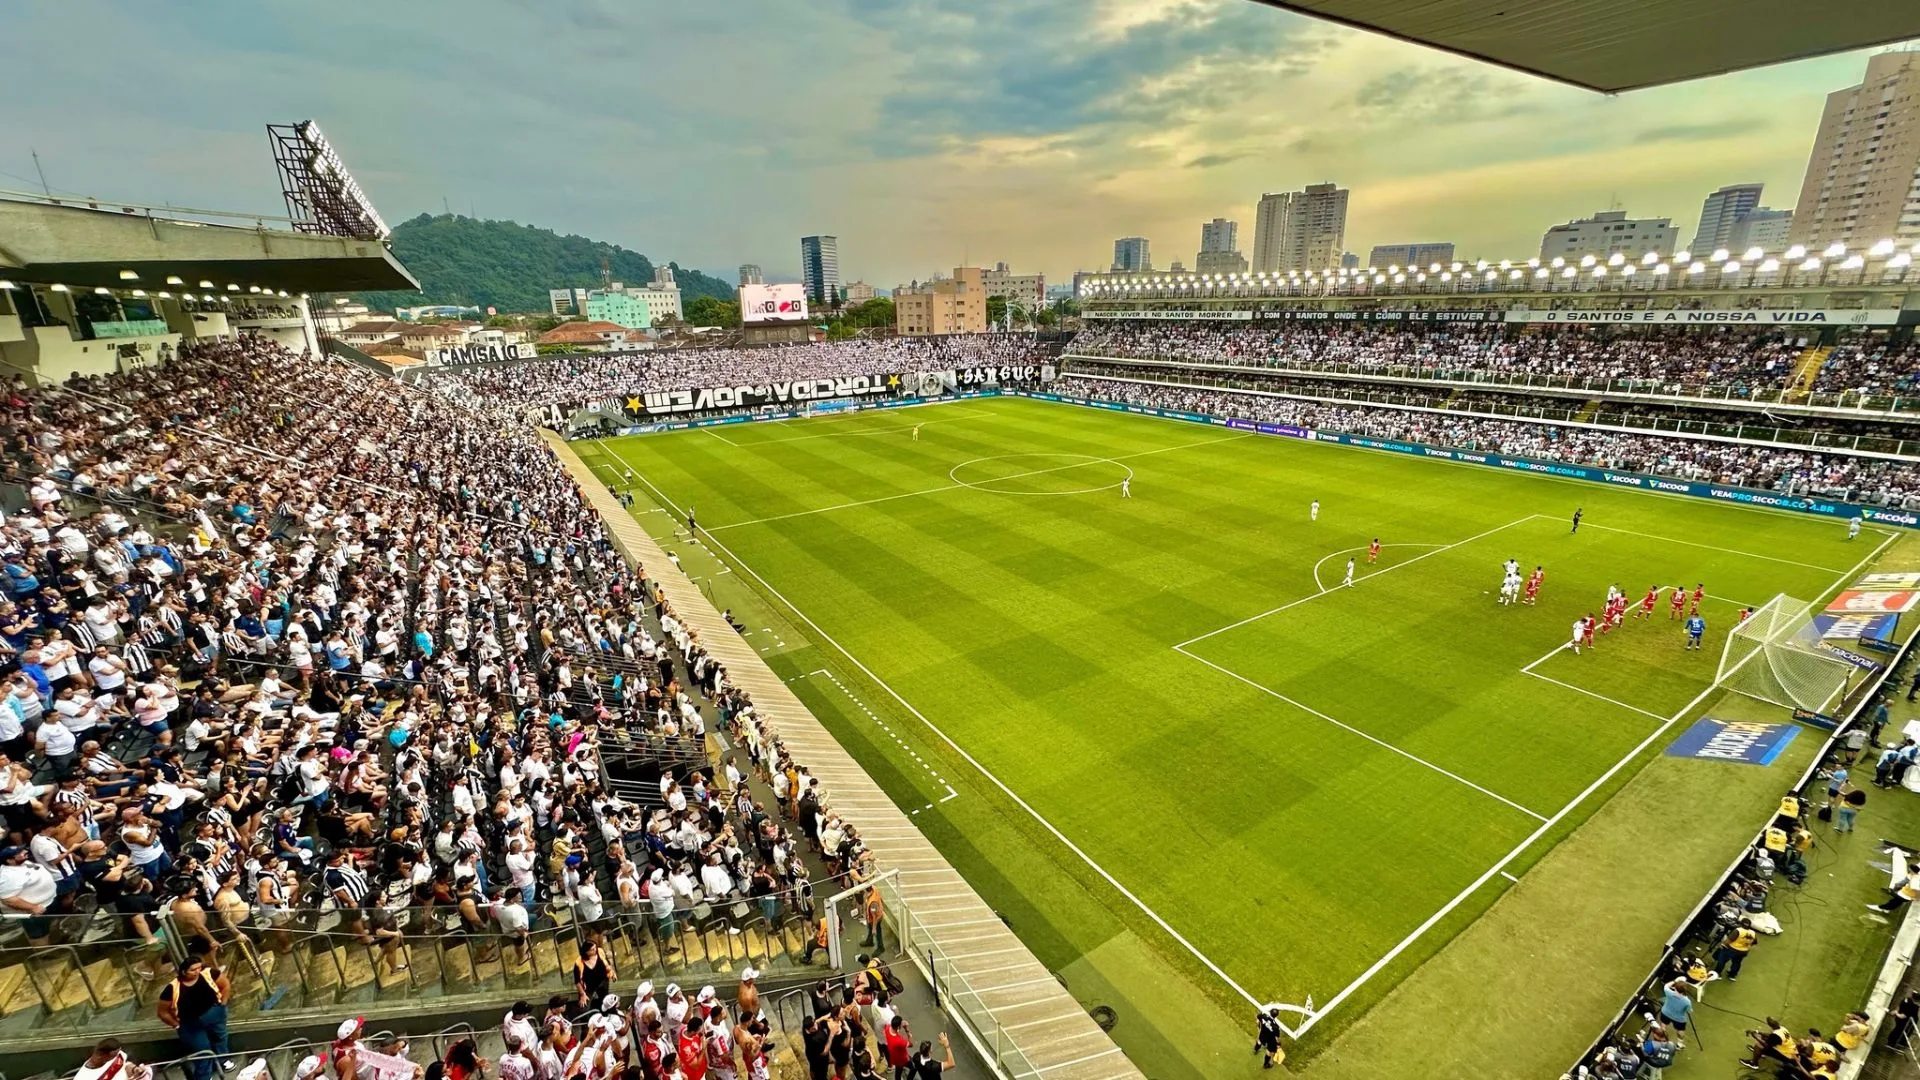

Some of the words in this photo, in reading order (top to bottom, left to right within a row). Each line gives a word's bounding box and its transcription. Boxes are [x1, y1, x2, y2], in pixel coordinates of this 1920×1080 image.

[767, 302, 774, 311] 0
[793, 302, 800, 311] 0
[1296, 312, 1328, 320] SANTOS
[1334, 312, 1357, 320] ONDE
[1375, 312, 1402, 320] COMO
[1409, 312, 1429, 320] ELE
[1436, 312, 1484, 321] ESTIVER
[1547, 312, 1557, 321] O
[1566, 312, 1633, 321] SANTOS
[1664, 312, 1677, 321] A
[1687, 312, 1757, 322] NOSSA
[1772, 312, 1827, 322] VIDA
[440, 345, 501, 366] CAMISA
[963, 365, 1034, 384] SANGUE
[773, 376, 887, 401] TORCIDA
[645, 387, 756, 414] JOVEM
[1430, 450, 1452, 458] SICOOB
[1463, 454, 1487, 463] SICOOB
[1501, 459, 1586, 477] VEMPROSICOOB.COM.BR
[1611, 475, 1642, 485] SICOOB
[1657, 481, 1690, 492] SICOOB
[1874, 511, 1918, 525] SICOOB
